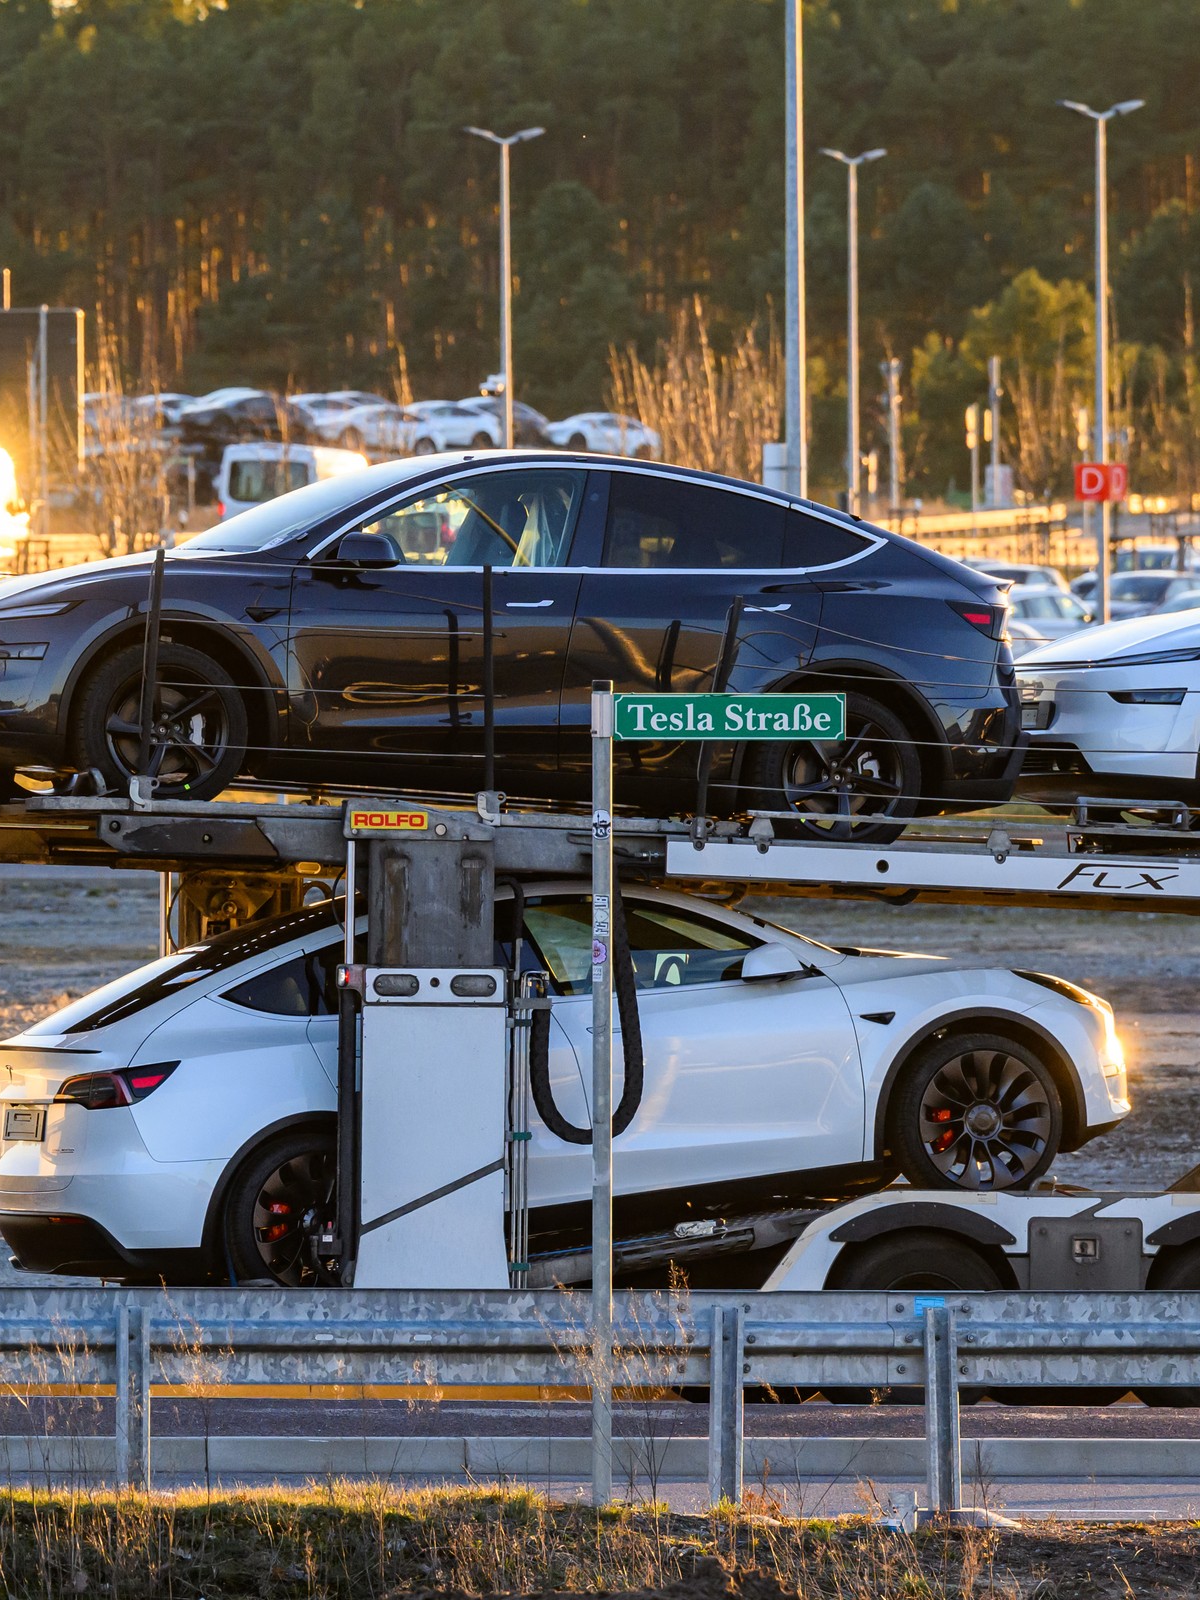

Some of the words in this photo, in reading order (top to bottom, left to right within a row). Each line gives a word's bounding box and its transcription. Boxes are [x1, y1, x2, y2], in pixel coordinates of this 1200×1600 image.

[1081, 467, 1104, 494] D
[627, 703, 715, 732] Tesla
[724, 703, 831, 732] Straße
[354, 813, 425, 827] ROLFO
[1057, 863, 1179, 890] FLX
